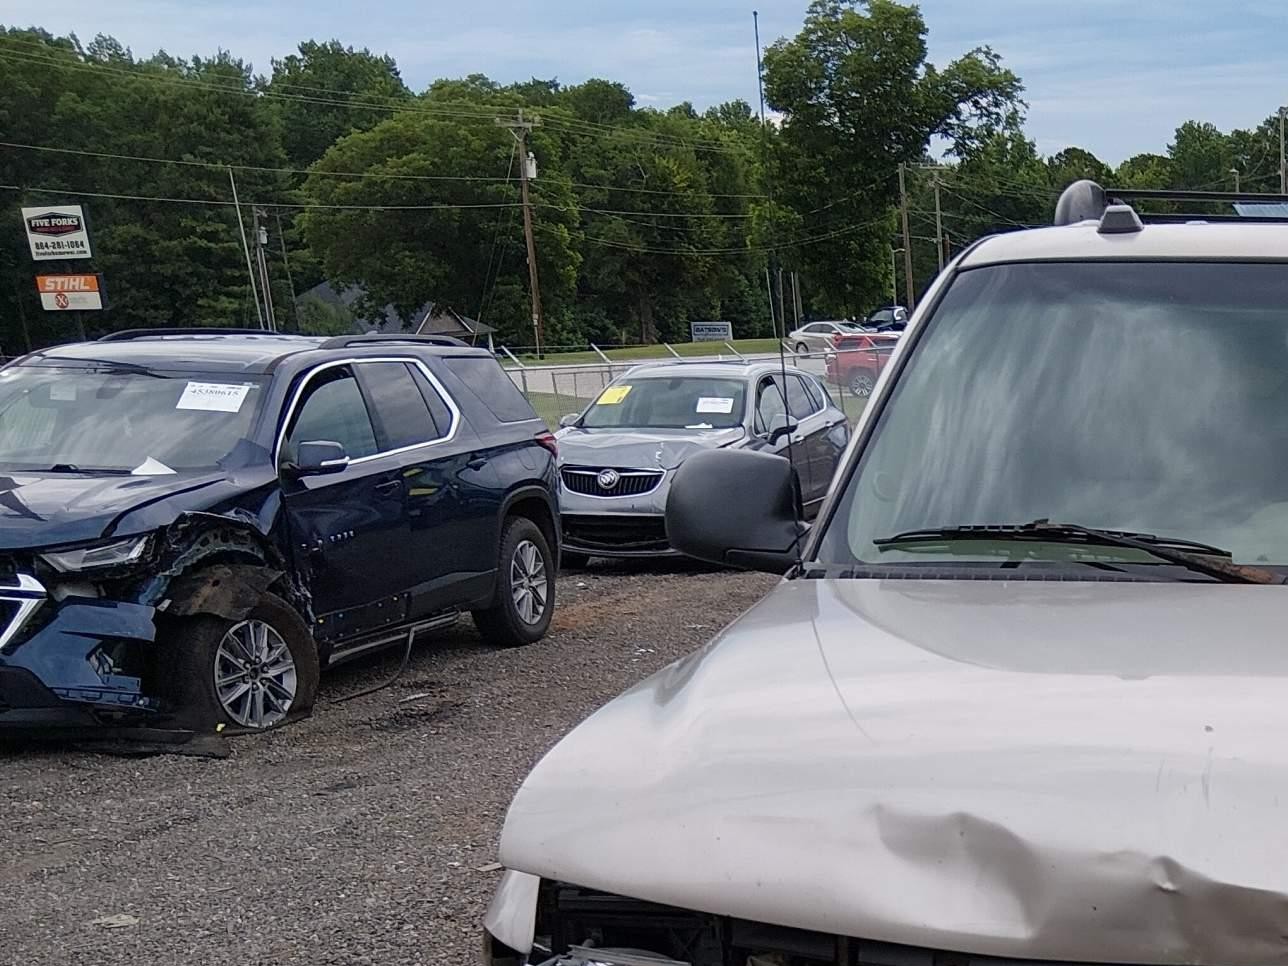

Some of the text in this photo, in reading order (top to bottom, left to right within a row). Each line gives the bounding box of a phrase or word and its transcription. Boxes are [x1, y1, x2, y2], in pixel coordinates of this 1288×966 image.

[31, 217, 78, 227] FIVE FORKS
[45, 277, 90, 290] STIHL
